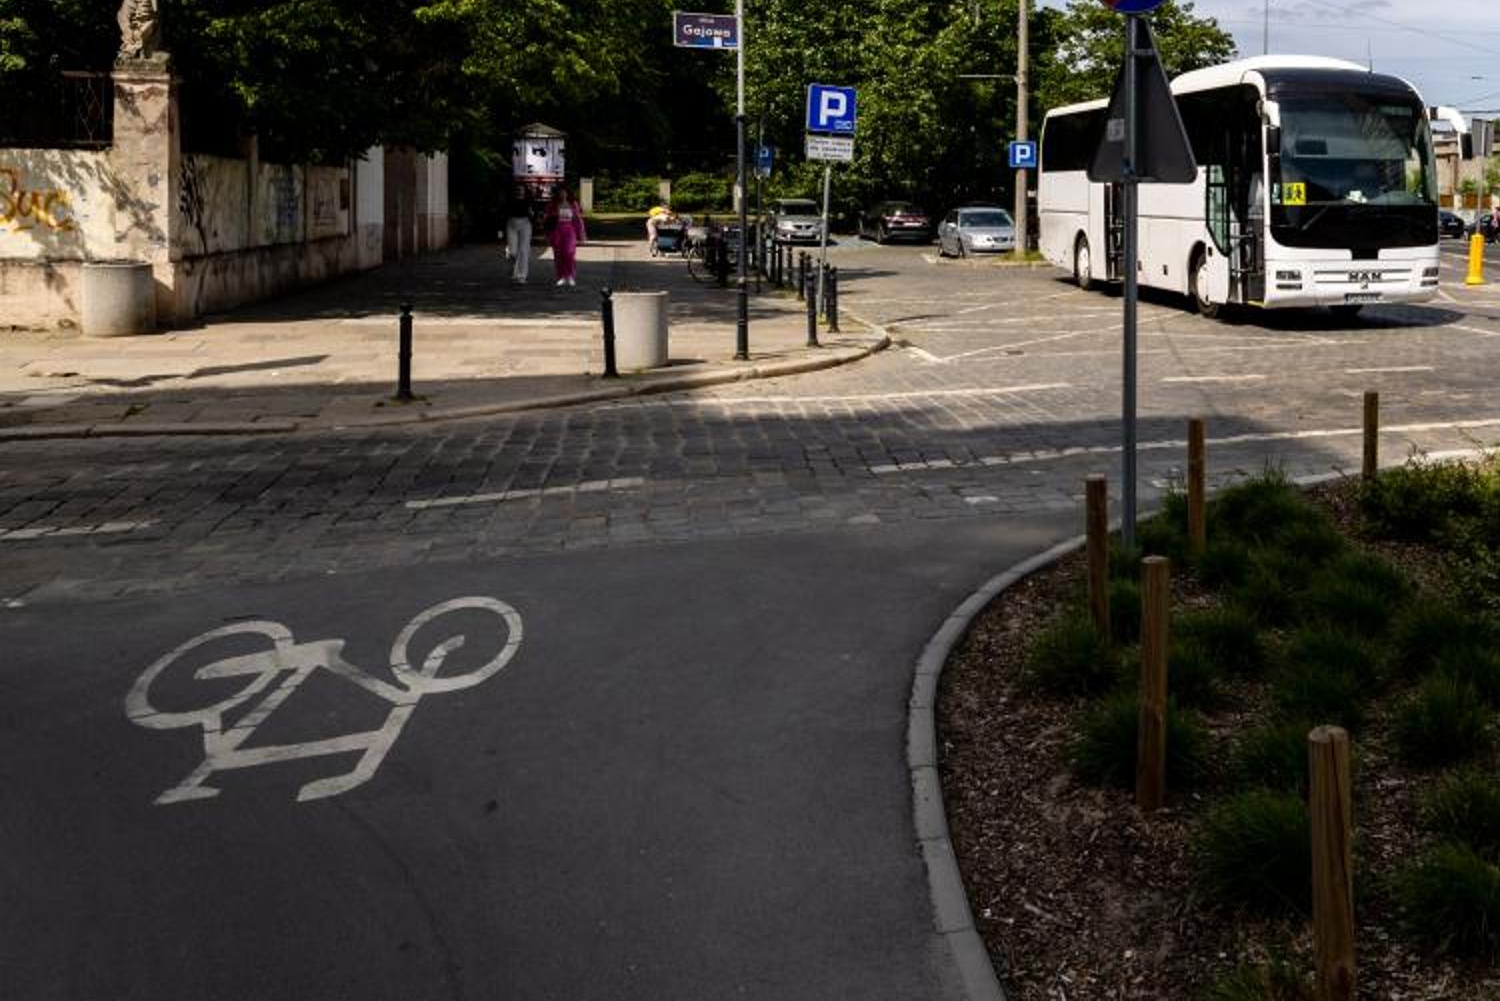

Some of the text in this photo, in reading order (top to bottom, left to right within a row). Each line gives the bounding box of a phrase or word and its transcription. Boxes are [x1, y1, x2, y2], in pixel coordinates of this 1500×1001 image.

[683, 24, 731, 38] Gajowa
[820, 90, 847, 126] P
[1016, 144, 1031, 164] P
